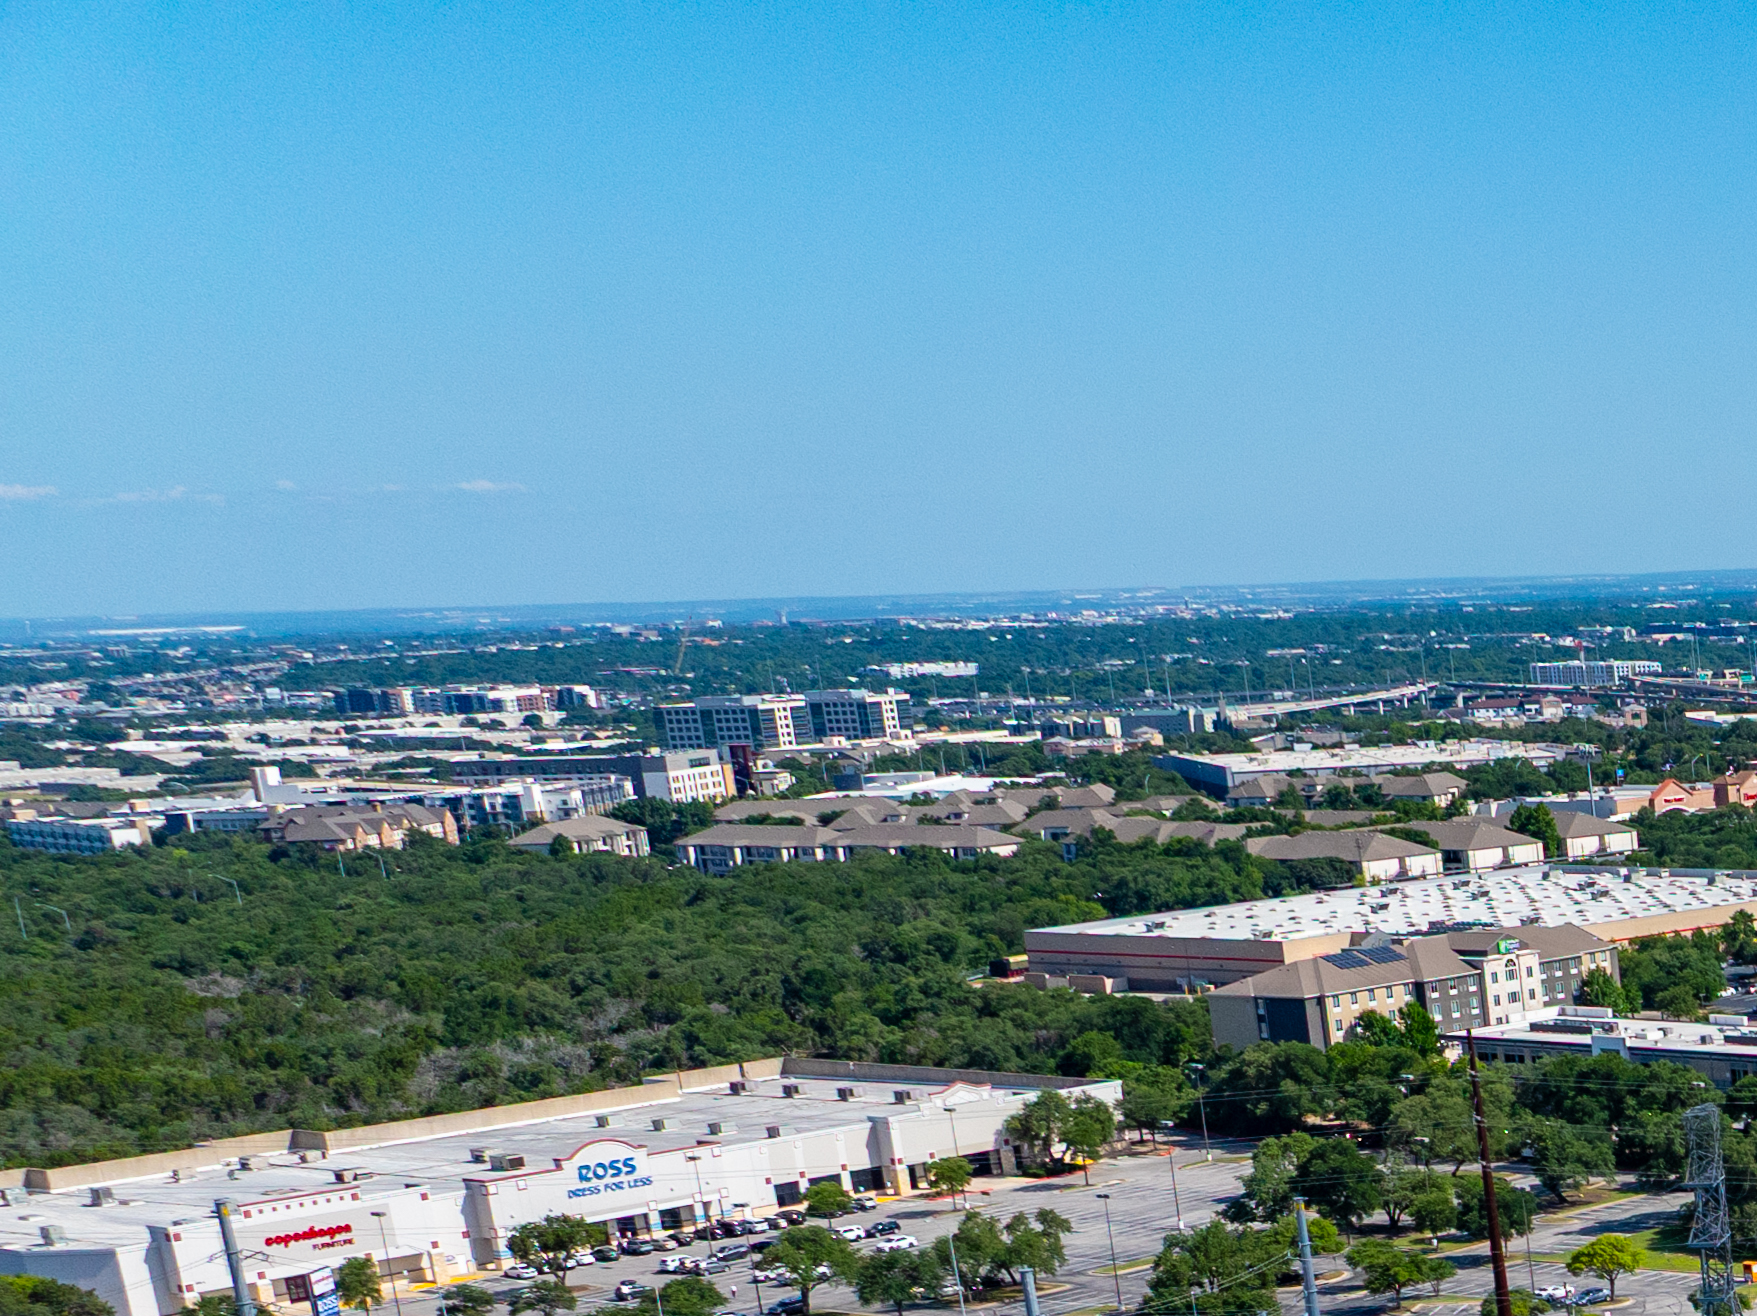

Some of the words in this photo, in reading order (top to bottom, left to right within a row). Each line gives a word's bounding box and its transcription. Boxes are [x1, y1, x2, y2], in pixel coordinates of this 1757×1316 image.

[578, 1157, 637, 1183] ROSS
[567, 1185, 601, 1199] DRESS
[604, 1181, 625, 1193] FOR
[628, 1176, 653, 1188] LESS
[312, 1238, 355, 1251] FURNITURE
